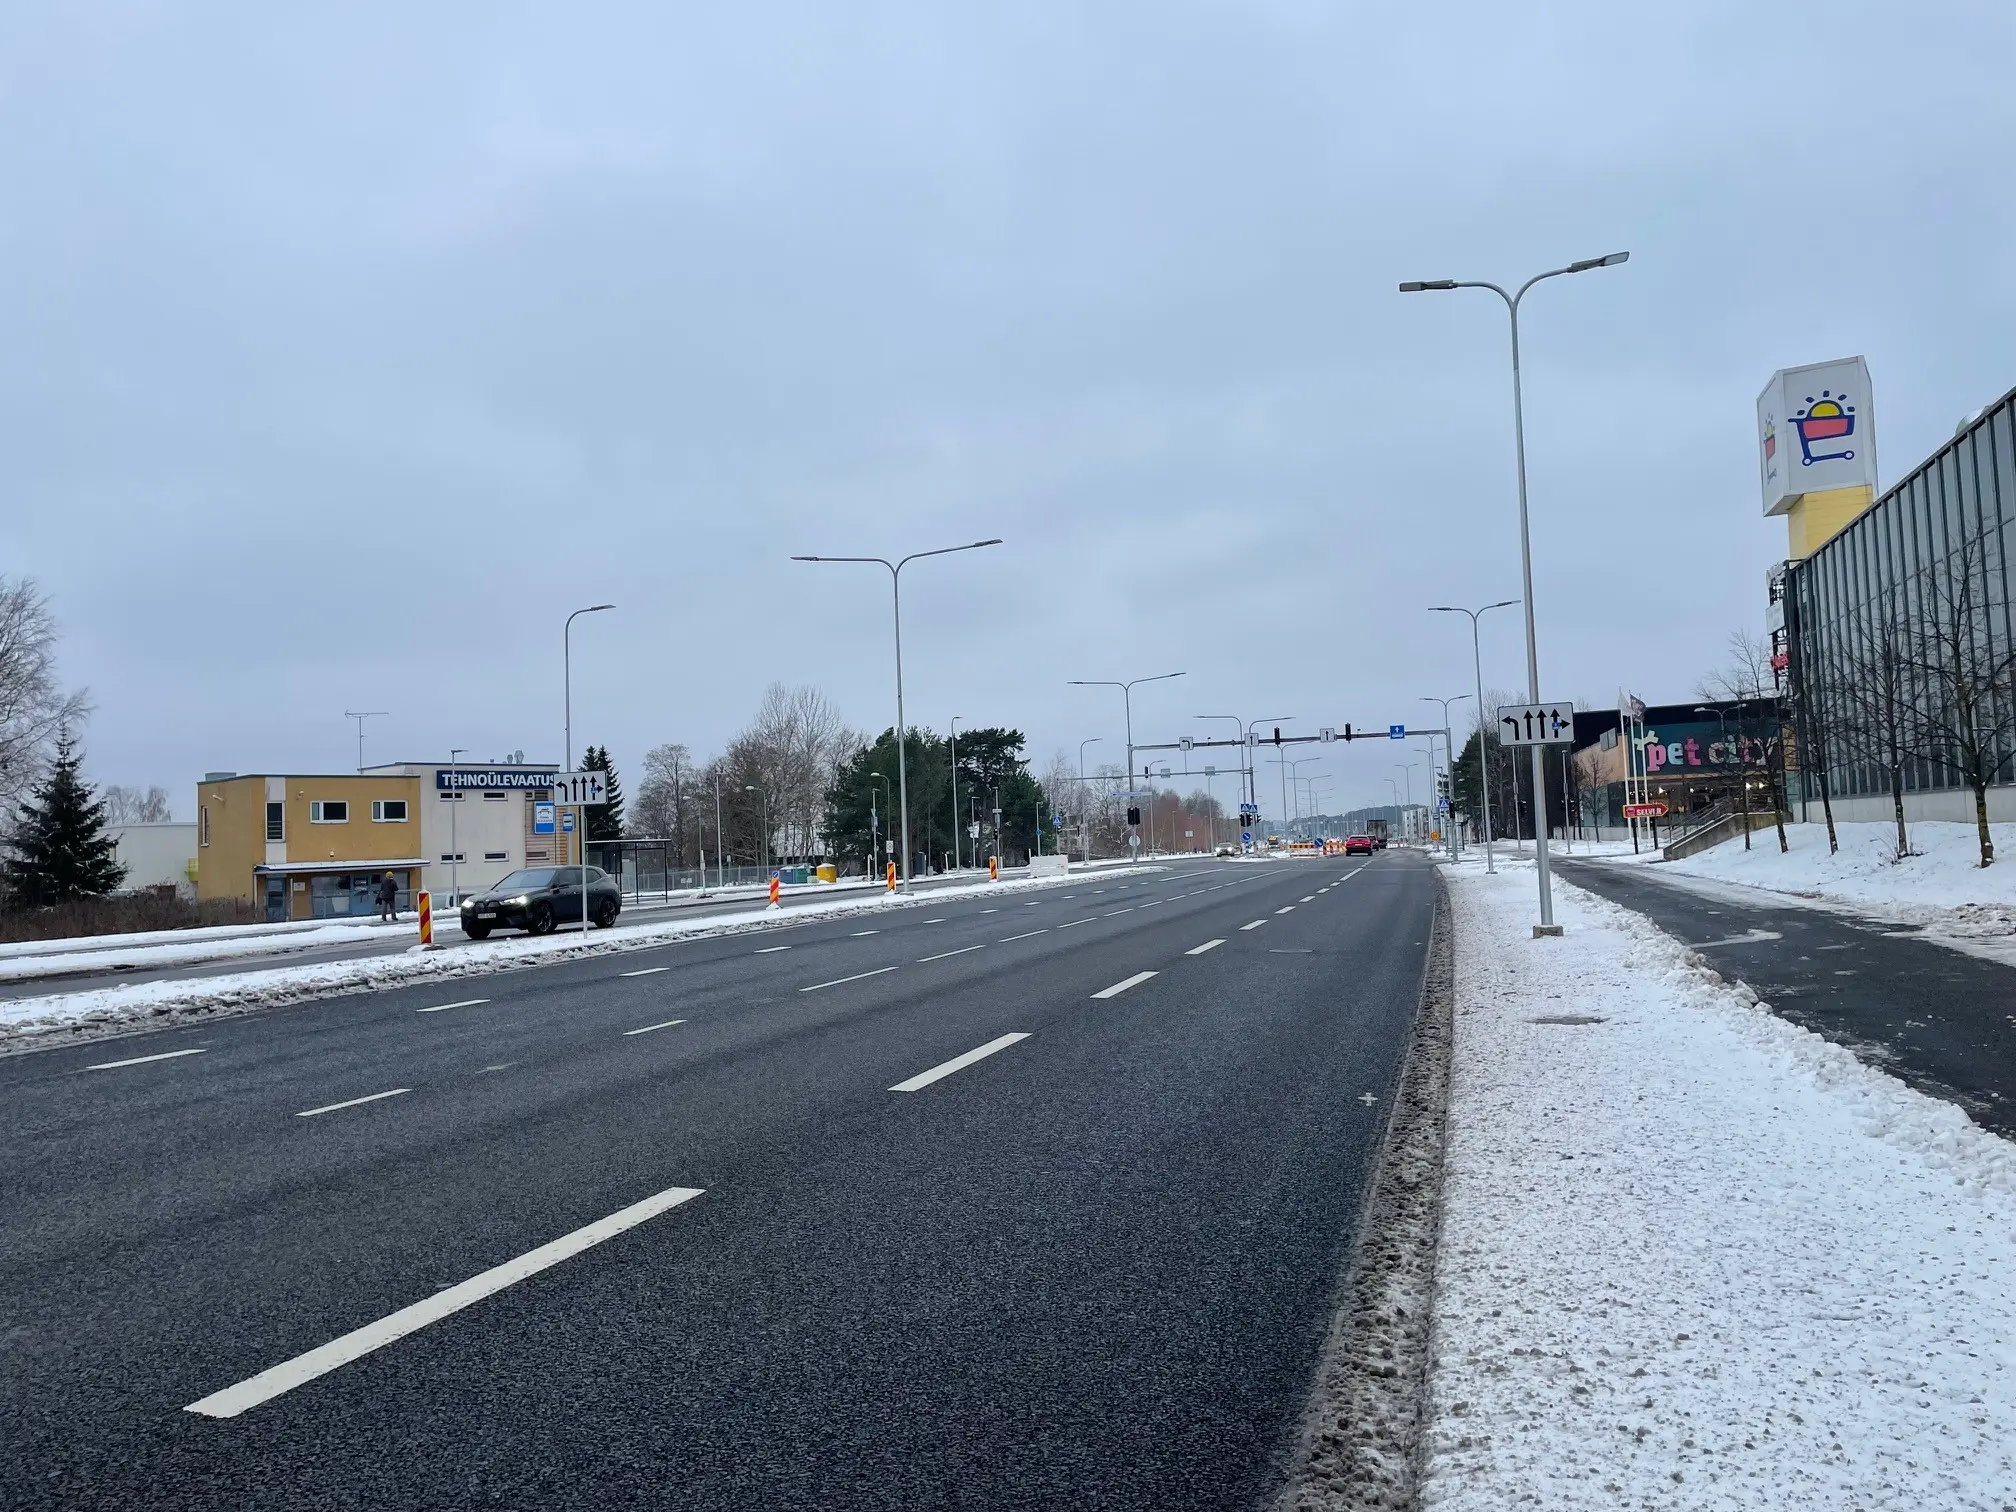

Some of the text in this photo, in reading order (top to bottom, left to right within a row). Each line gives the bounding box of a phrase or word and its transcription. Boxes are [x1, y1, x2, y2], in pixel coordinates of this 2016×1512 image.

[1647, 734, 1779, 772] pet city
[441, 771, 554, 786] TEHNOÜLEVAATUS
